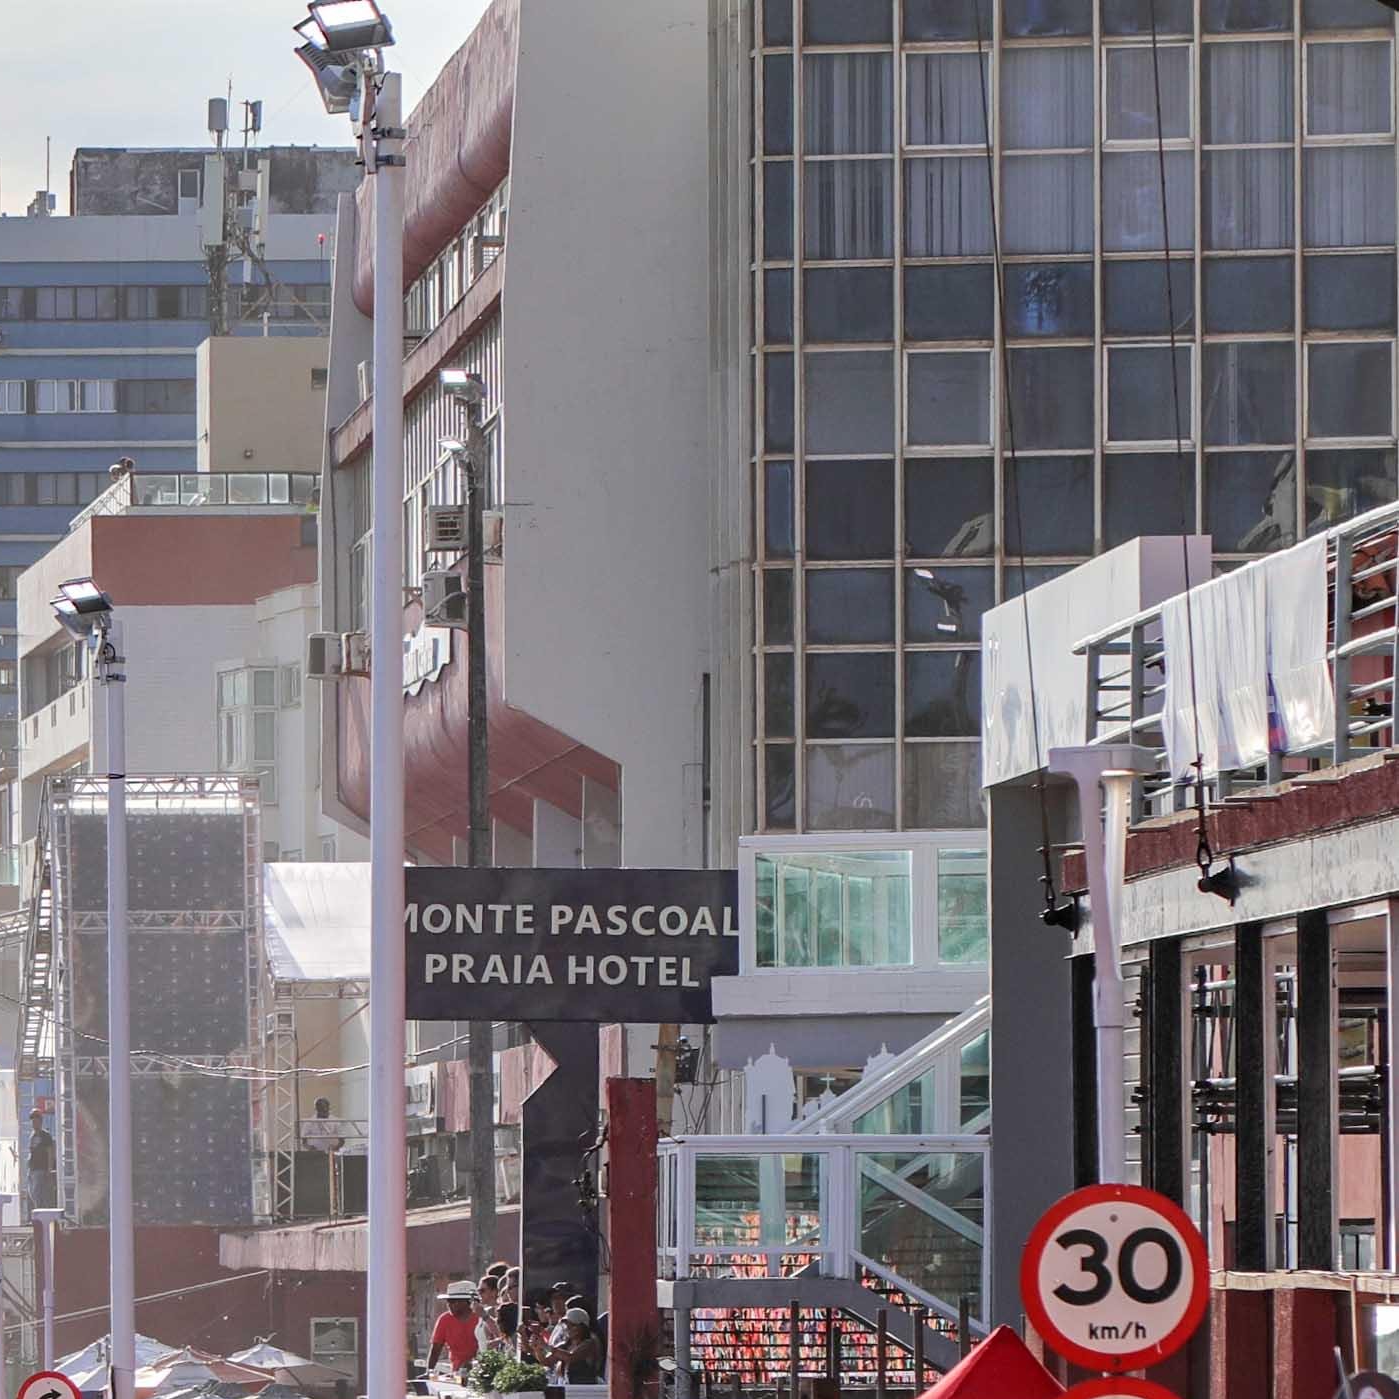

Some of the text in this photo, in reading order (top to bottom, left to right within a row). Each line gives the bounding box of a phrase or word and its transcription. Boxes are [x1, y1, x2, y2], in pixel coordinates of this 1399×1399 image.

[551, 905, 739, 937] PASCOAL
[425, 954, 700, 988] PRAIA HOTEL
[1053, 1227, 1183, 1306] 30
[1089, 1322, 1147, 1340] km/h
